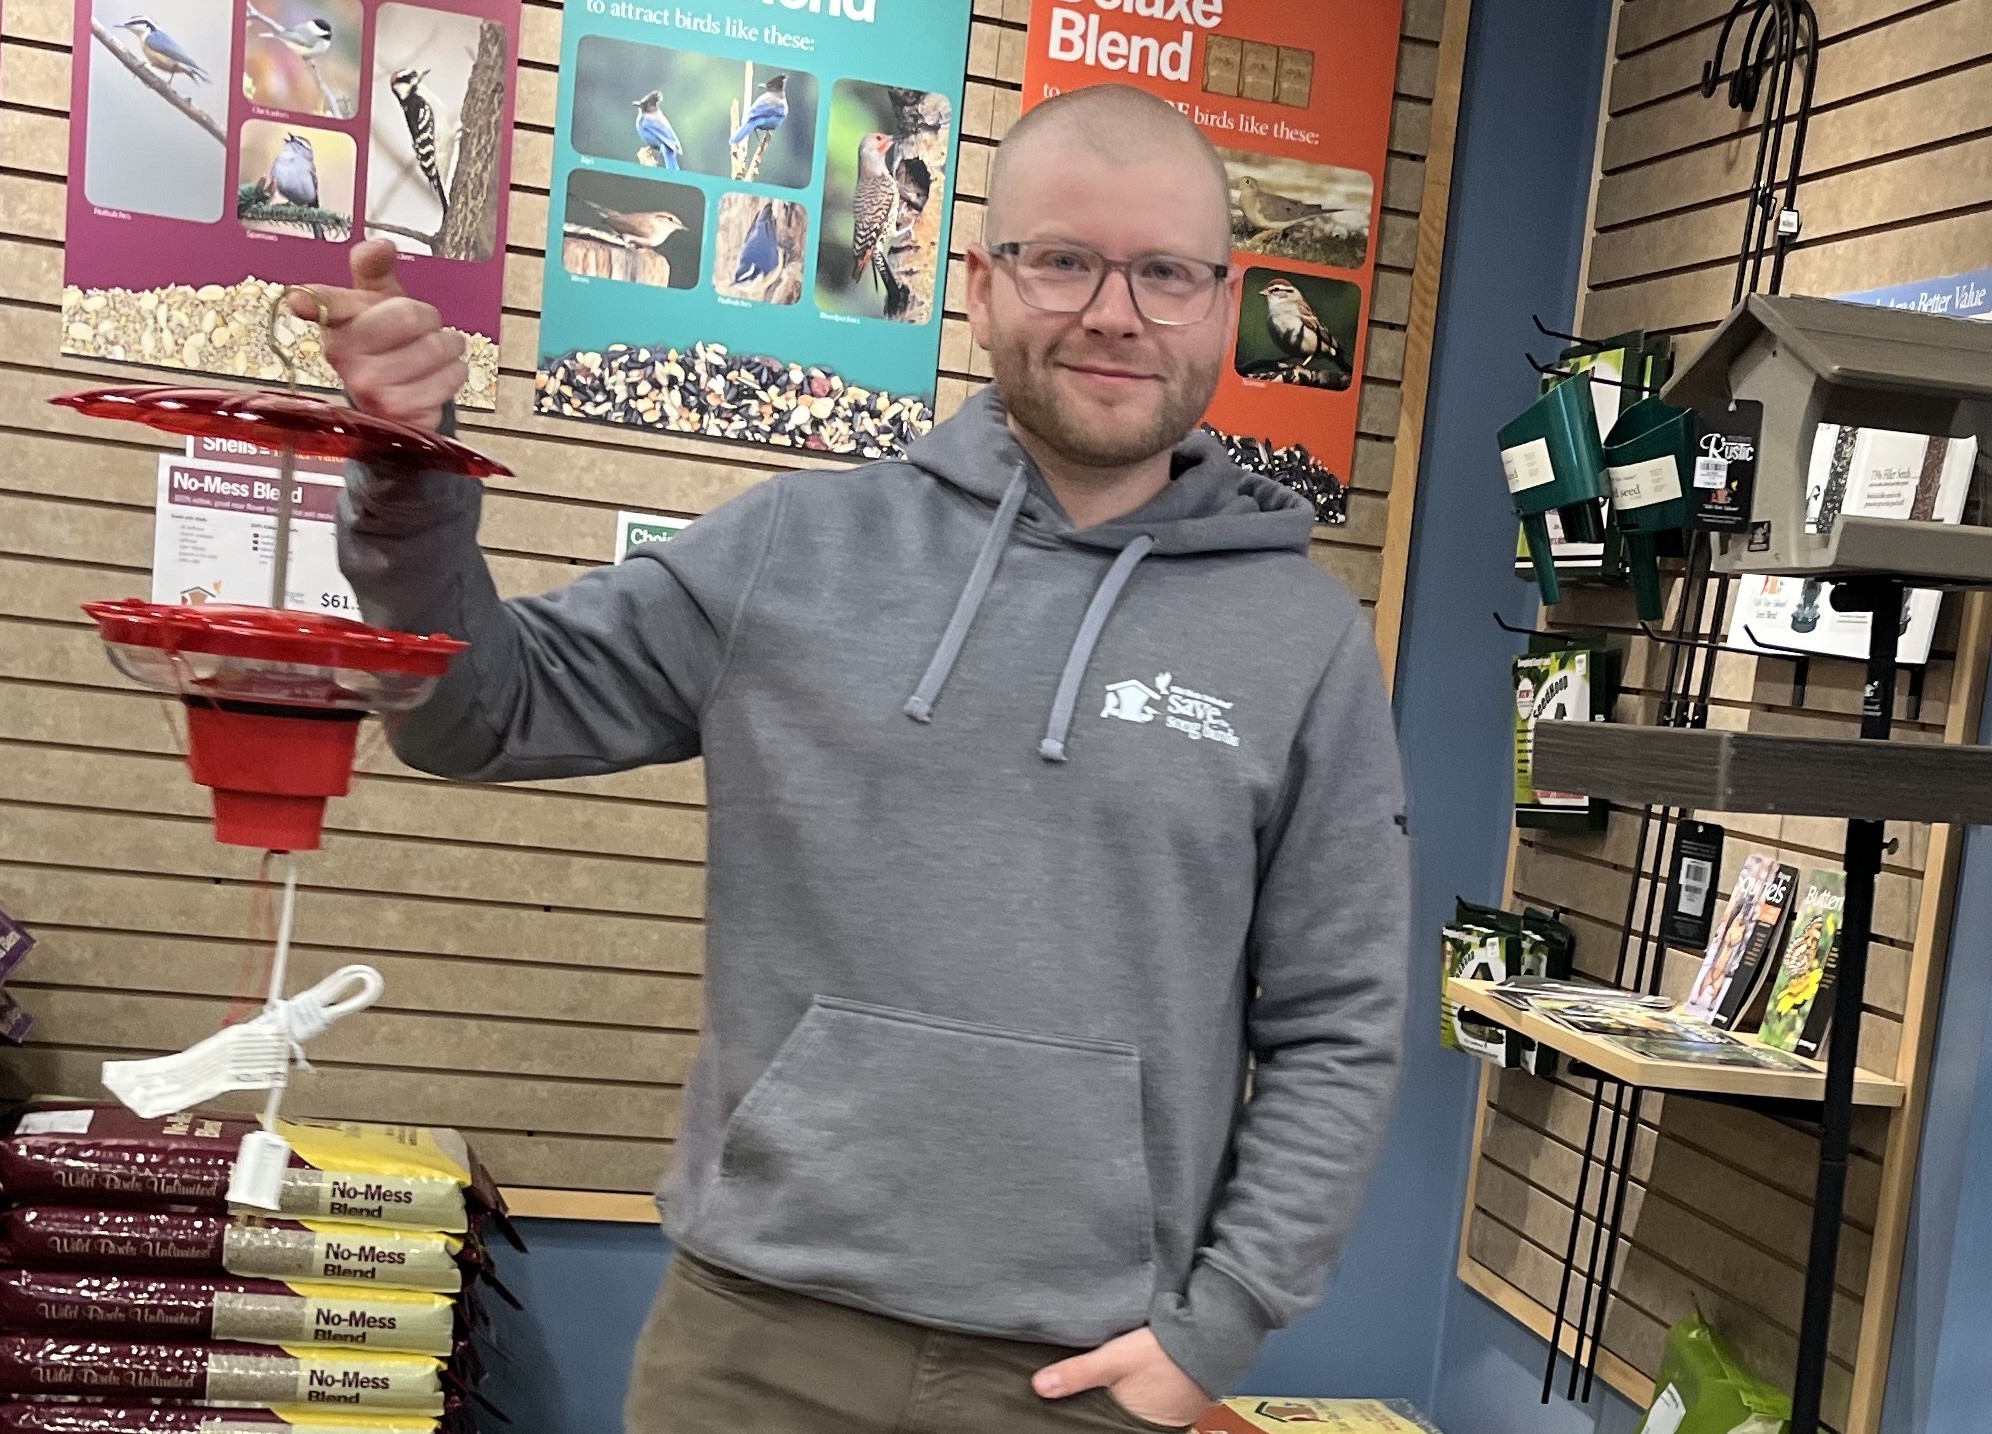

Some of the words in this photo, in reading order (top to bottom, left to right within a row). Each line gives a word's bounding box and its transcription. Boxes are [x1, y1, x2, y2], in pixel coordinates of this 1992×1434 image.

[610, 5, 670, 26] attract
[675, 8, 721, 35] birds
[725, 20, 759, 42] like
[763, 25, 815, 52] these:
[1048, 7, 1194, 83] Blend
[1043, 83, 1061, 98] to
[1194, 105, 1235, 130] birds
[1239, 115, 1269, 137] like
[1273, 120, 1320, 146] these:
[1917, 292, 1952, 314] Better
[1955, 281, 1987, 310] Value
[173, 471, 250, 498] No-Mess
[253, 481, 303, 504] Bled
[630, 528, 674, 545] Choi
[331, 1181, 413, 1204] No-Mess
[330, 1202, 383, 1218] Blend
[325, 1242, 406, 1265] No-Mess
[323, 1263, 376, 1279] Blend
[315, 1308, 397, 1330] No-Mess
[313, 1328, 367, 1344] Blend
[309, 1369, 391, 1390] No-Mess
[307, 1390, 360, 1404] Blend
